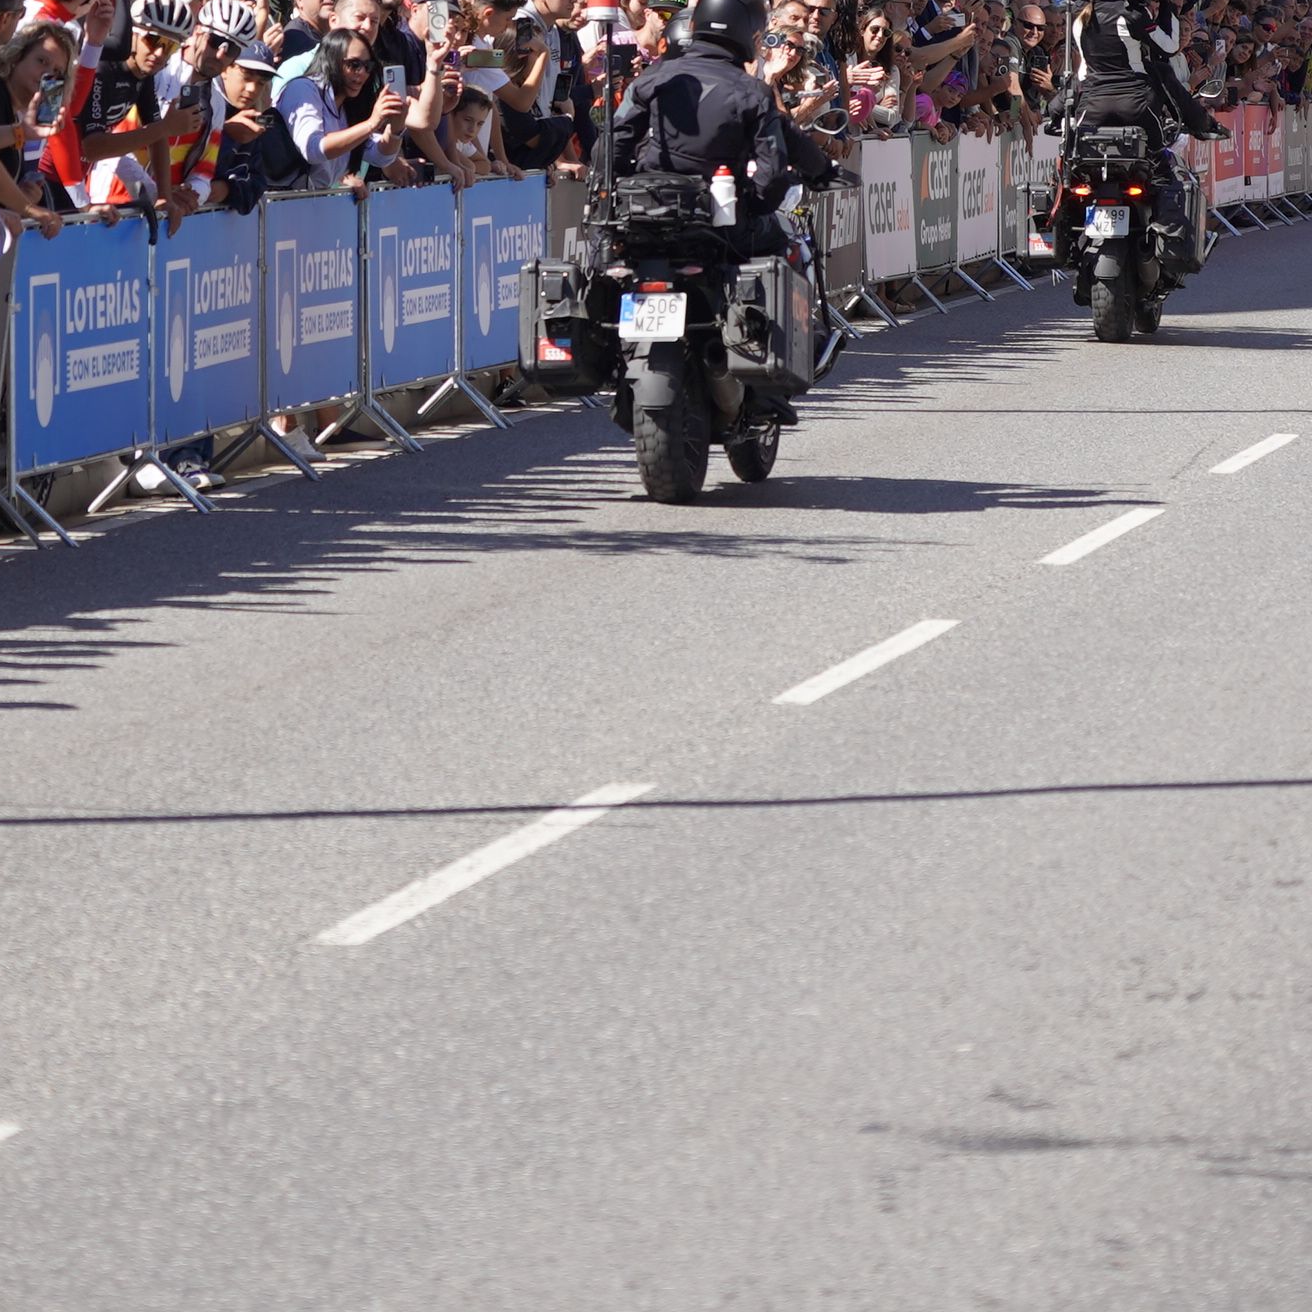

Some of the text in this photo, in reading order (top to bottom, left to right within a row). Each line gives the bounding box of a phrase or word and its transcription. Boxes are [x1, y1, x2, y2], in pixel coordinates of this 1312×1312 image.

[928, 149, 952, 200] caser
[963, 168, 986, 220] caser
[868, 181, 896, 234] caser
[401, 225, 450, 277] LOTERÍAS
[496, 214, 542, 264] LOTERÍAS
[921, 219, 938, 251] Grupo
[194, 254, 252, 315] LOTERÍAS
[300, 239, 353, 294] LOTERÍAS
[66, 270, 141, 334] LOTERÍAS
[304, 310, 350, 335] CON EL DEPORTE
[405, 292, 447, 317] CON EL DEPORTE
[635, 316, 665, 333] MZF
[636, 299, 678, 314] 7506
[72, 350, 134, 381] CON EL DEPORTE
[198, 329, 247, 359] CON EL DEPORTE
